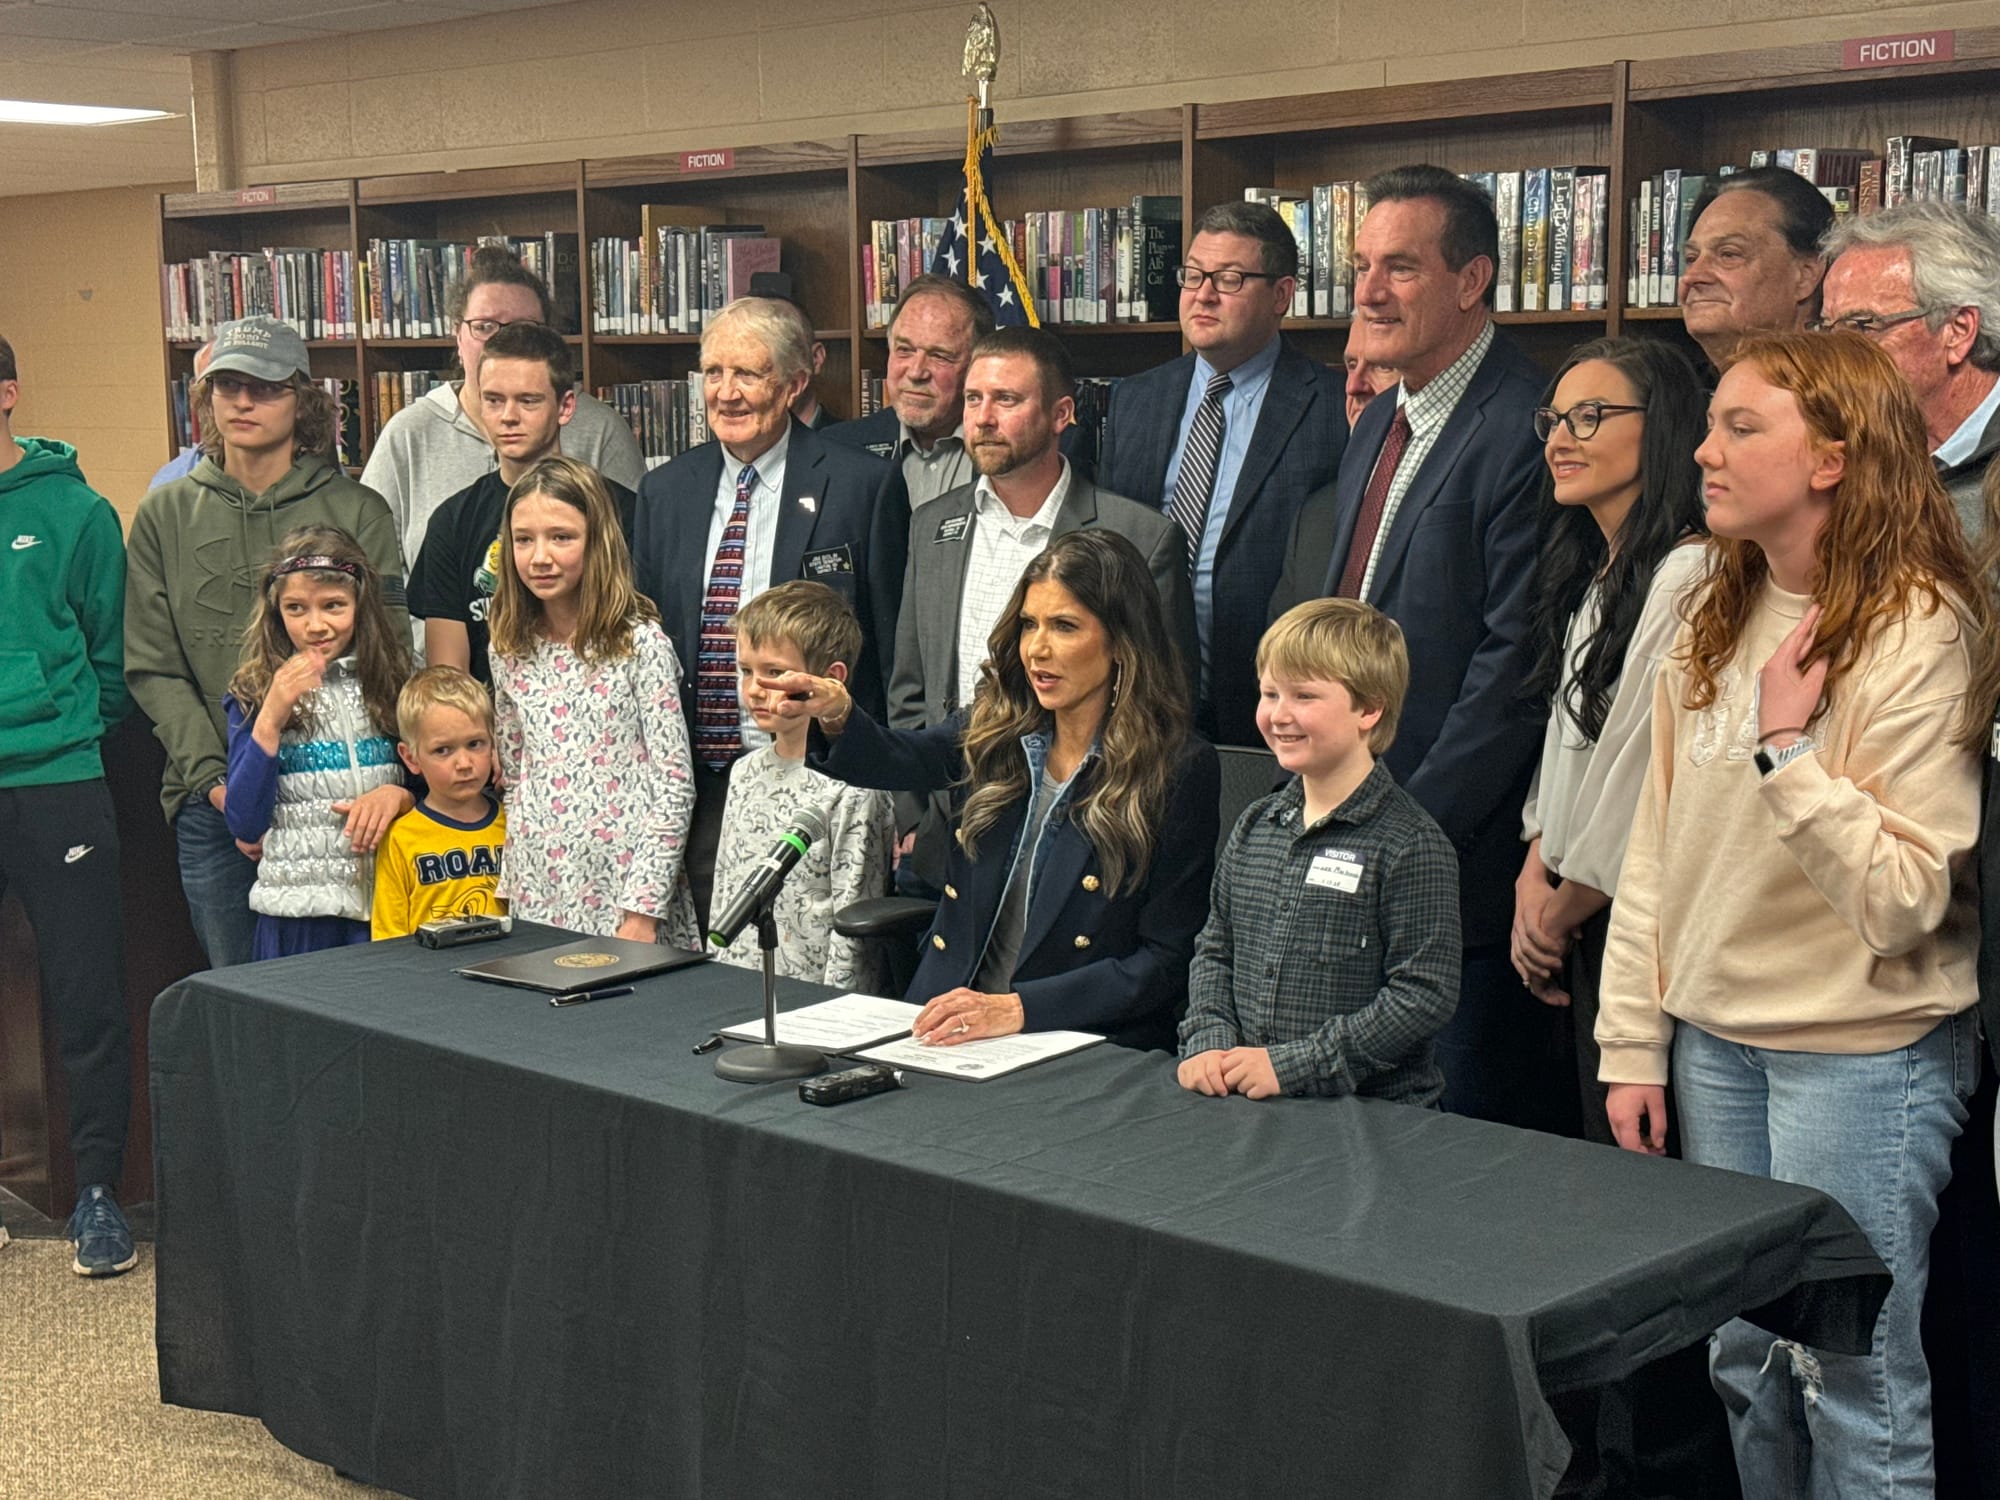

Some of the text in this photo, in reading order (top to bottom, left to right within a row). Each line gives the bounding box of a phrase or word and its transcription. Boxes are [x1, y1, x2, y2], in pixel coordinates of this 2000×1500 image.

[1860, 38, 1935, 62] FICTION
[688, 153, 725, 168] FICTION
[242, 191, 269, 203] FICTION
[1652, 196, 1661, 231] CARTER
[695, 398, 705, 443] LOR
[189, 624, 246, 648] FRE
[1325, 848, 1356, 862] VISITOR
